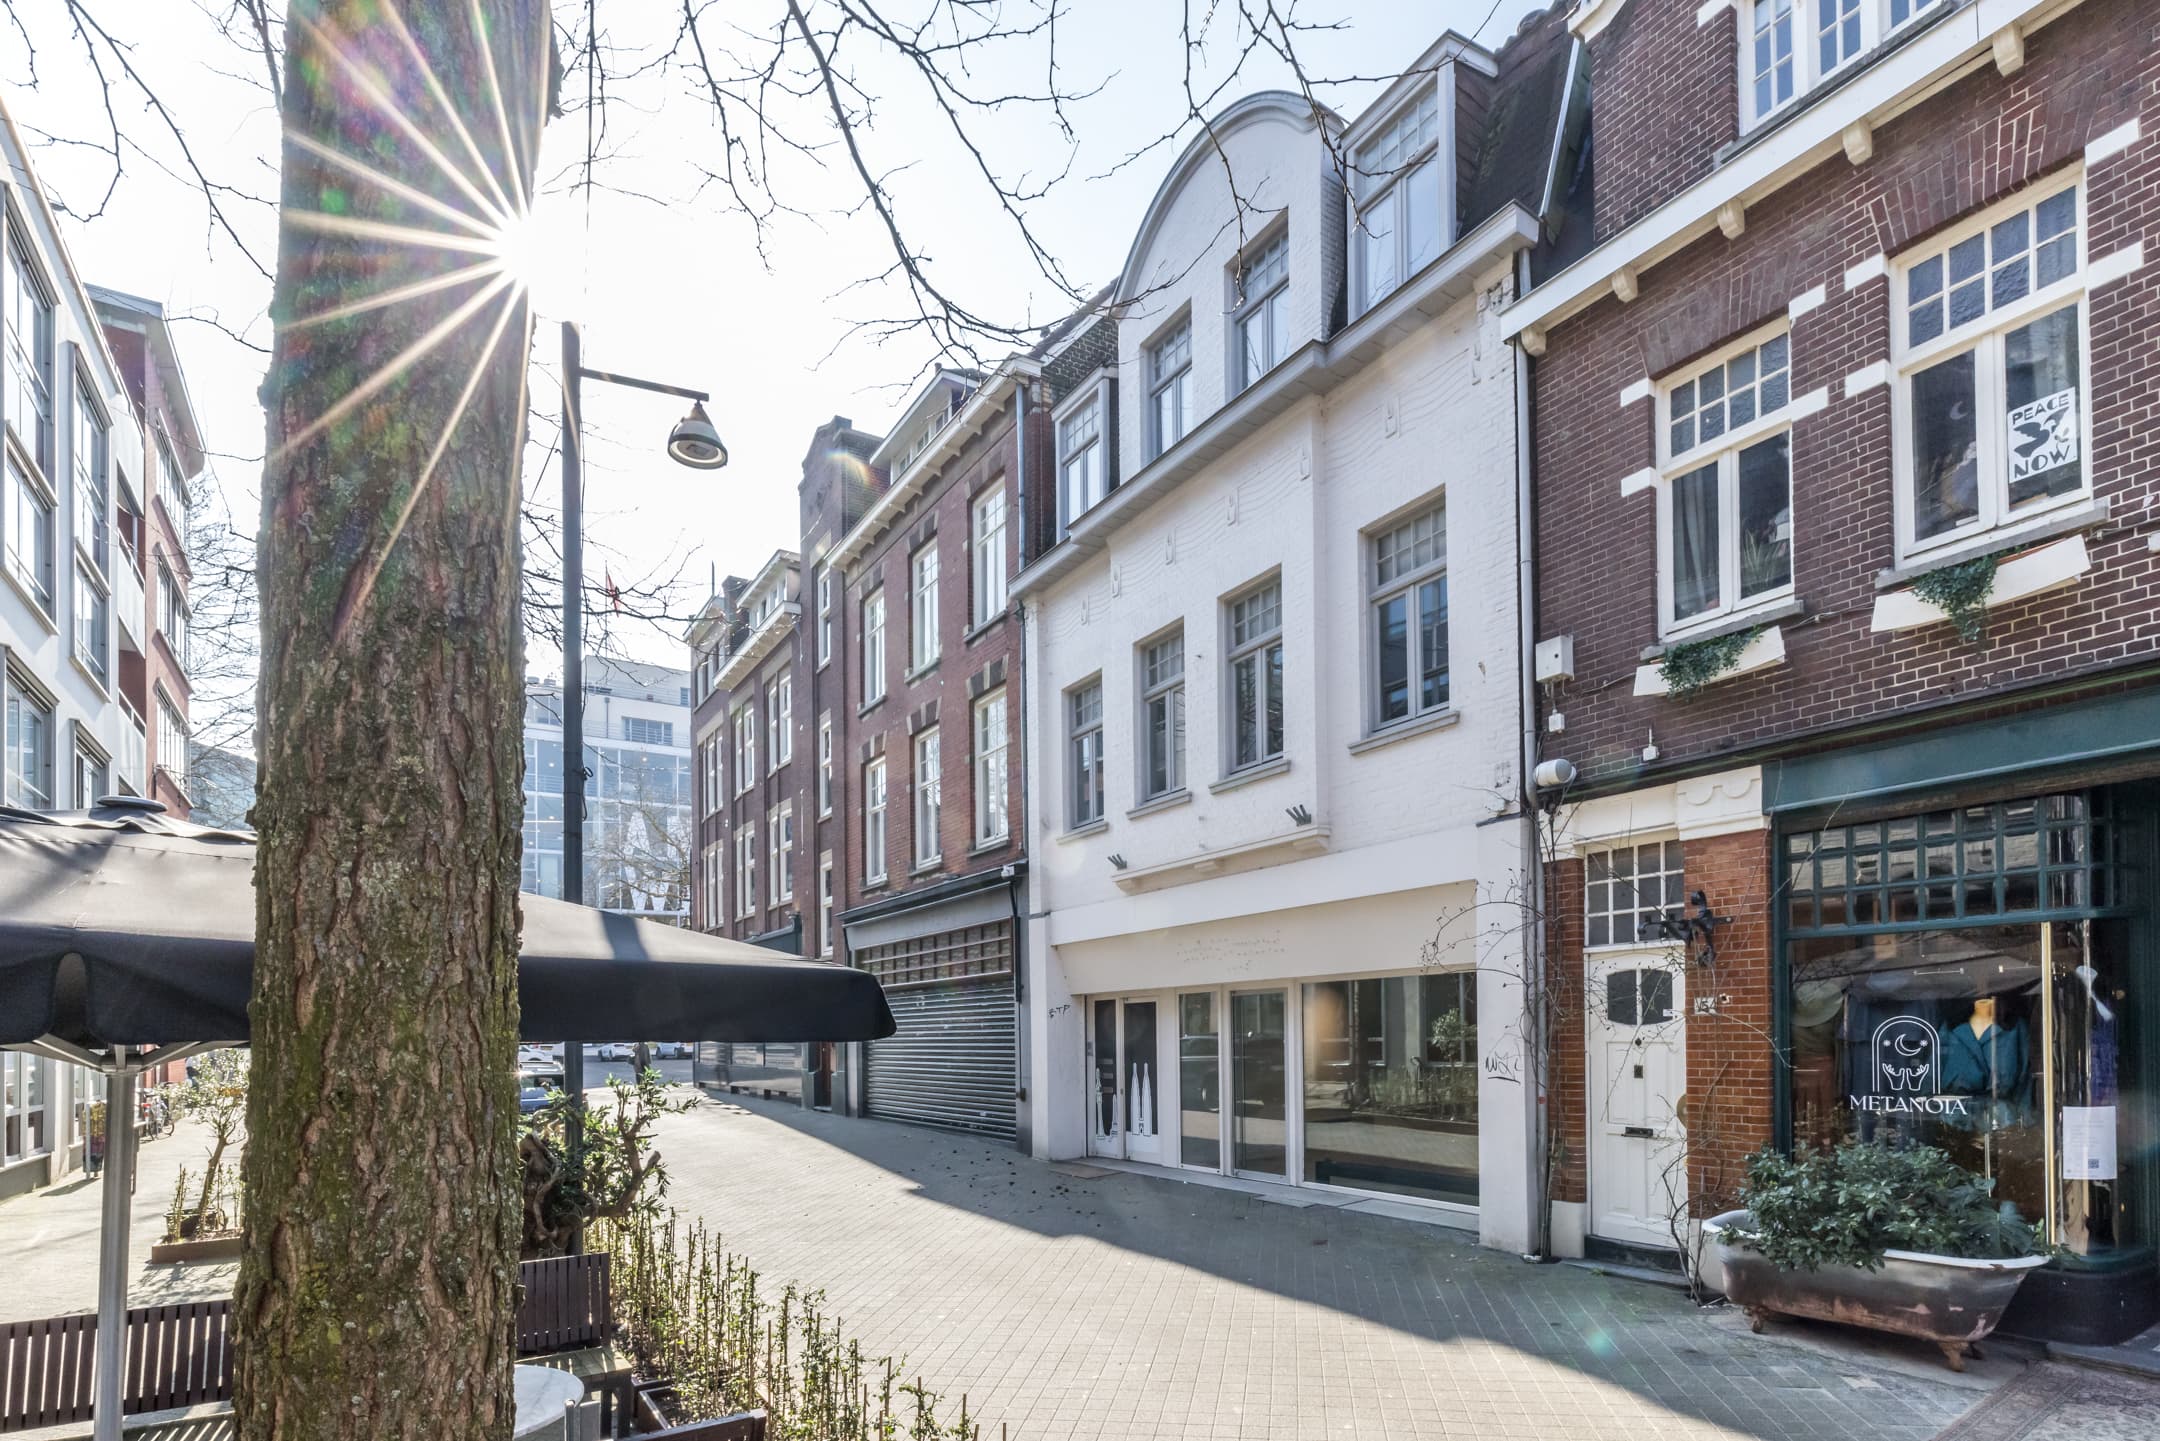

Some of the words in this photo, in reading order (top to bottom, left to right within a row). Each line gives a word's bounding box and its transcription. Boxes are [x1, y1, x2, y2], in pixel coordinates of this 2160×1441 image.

[2012, 393, 2069, 425] PEACE
[2014, 444, 2071, 479] NOW
[1849, 1094, 1968, 1115] METANOIA
